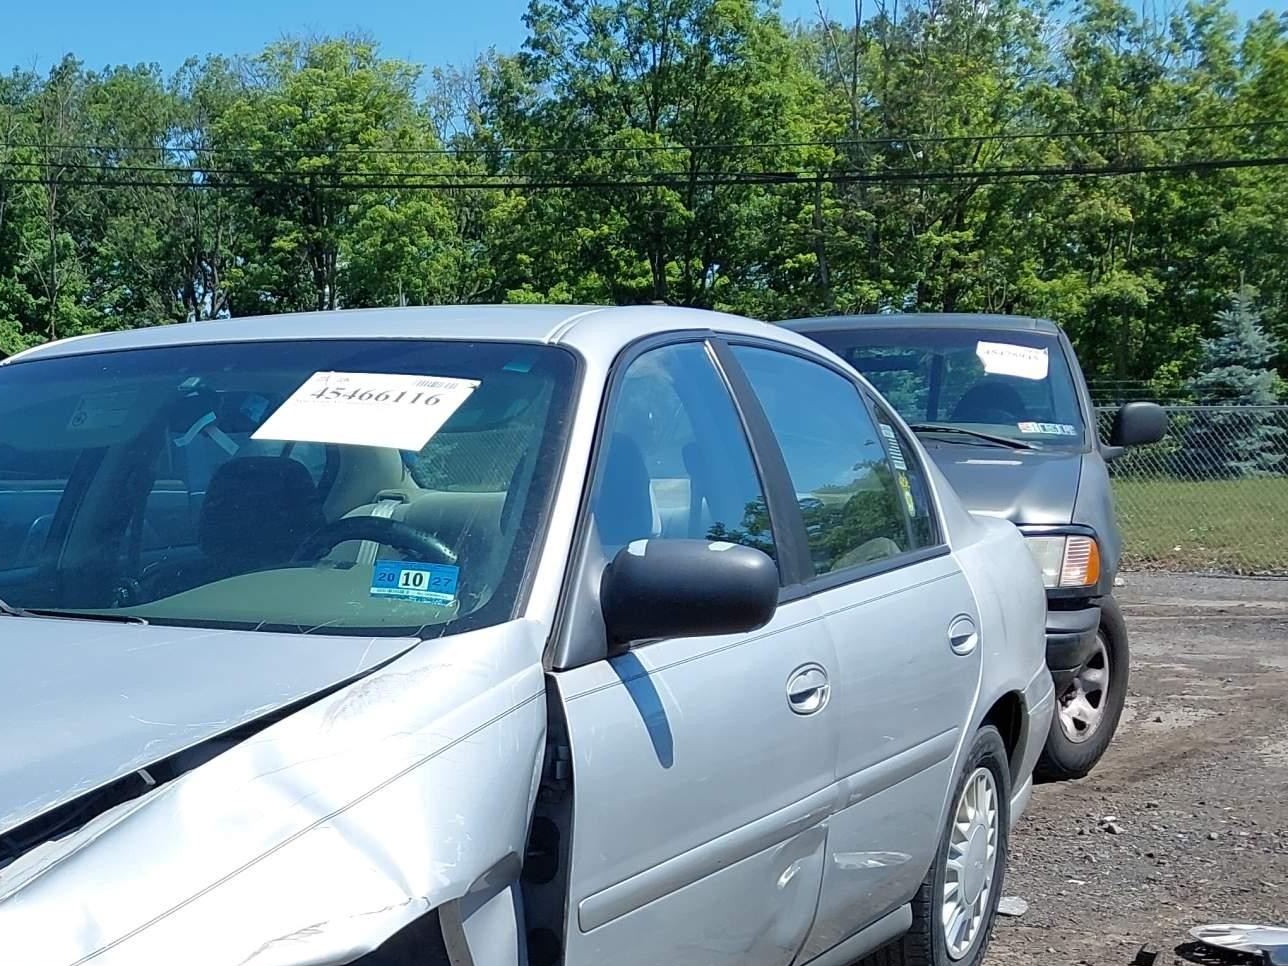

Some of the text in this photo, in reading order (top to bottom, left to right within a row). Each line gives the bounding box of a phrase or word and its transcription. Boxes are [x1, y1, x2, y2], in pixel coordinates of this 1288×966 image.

[310, 386, 442, 407] 45466116
[377, 571, 453, 587] 20 10 27
